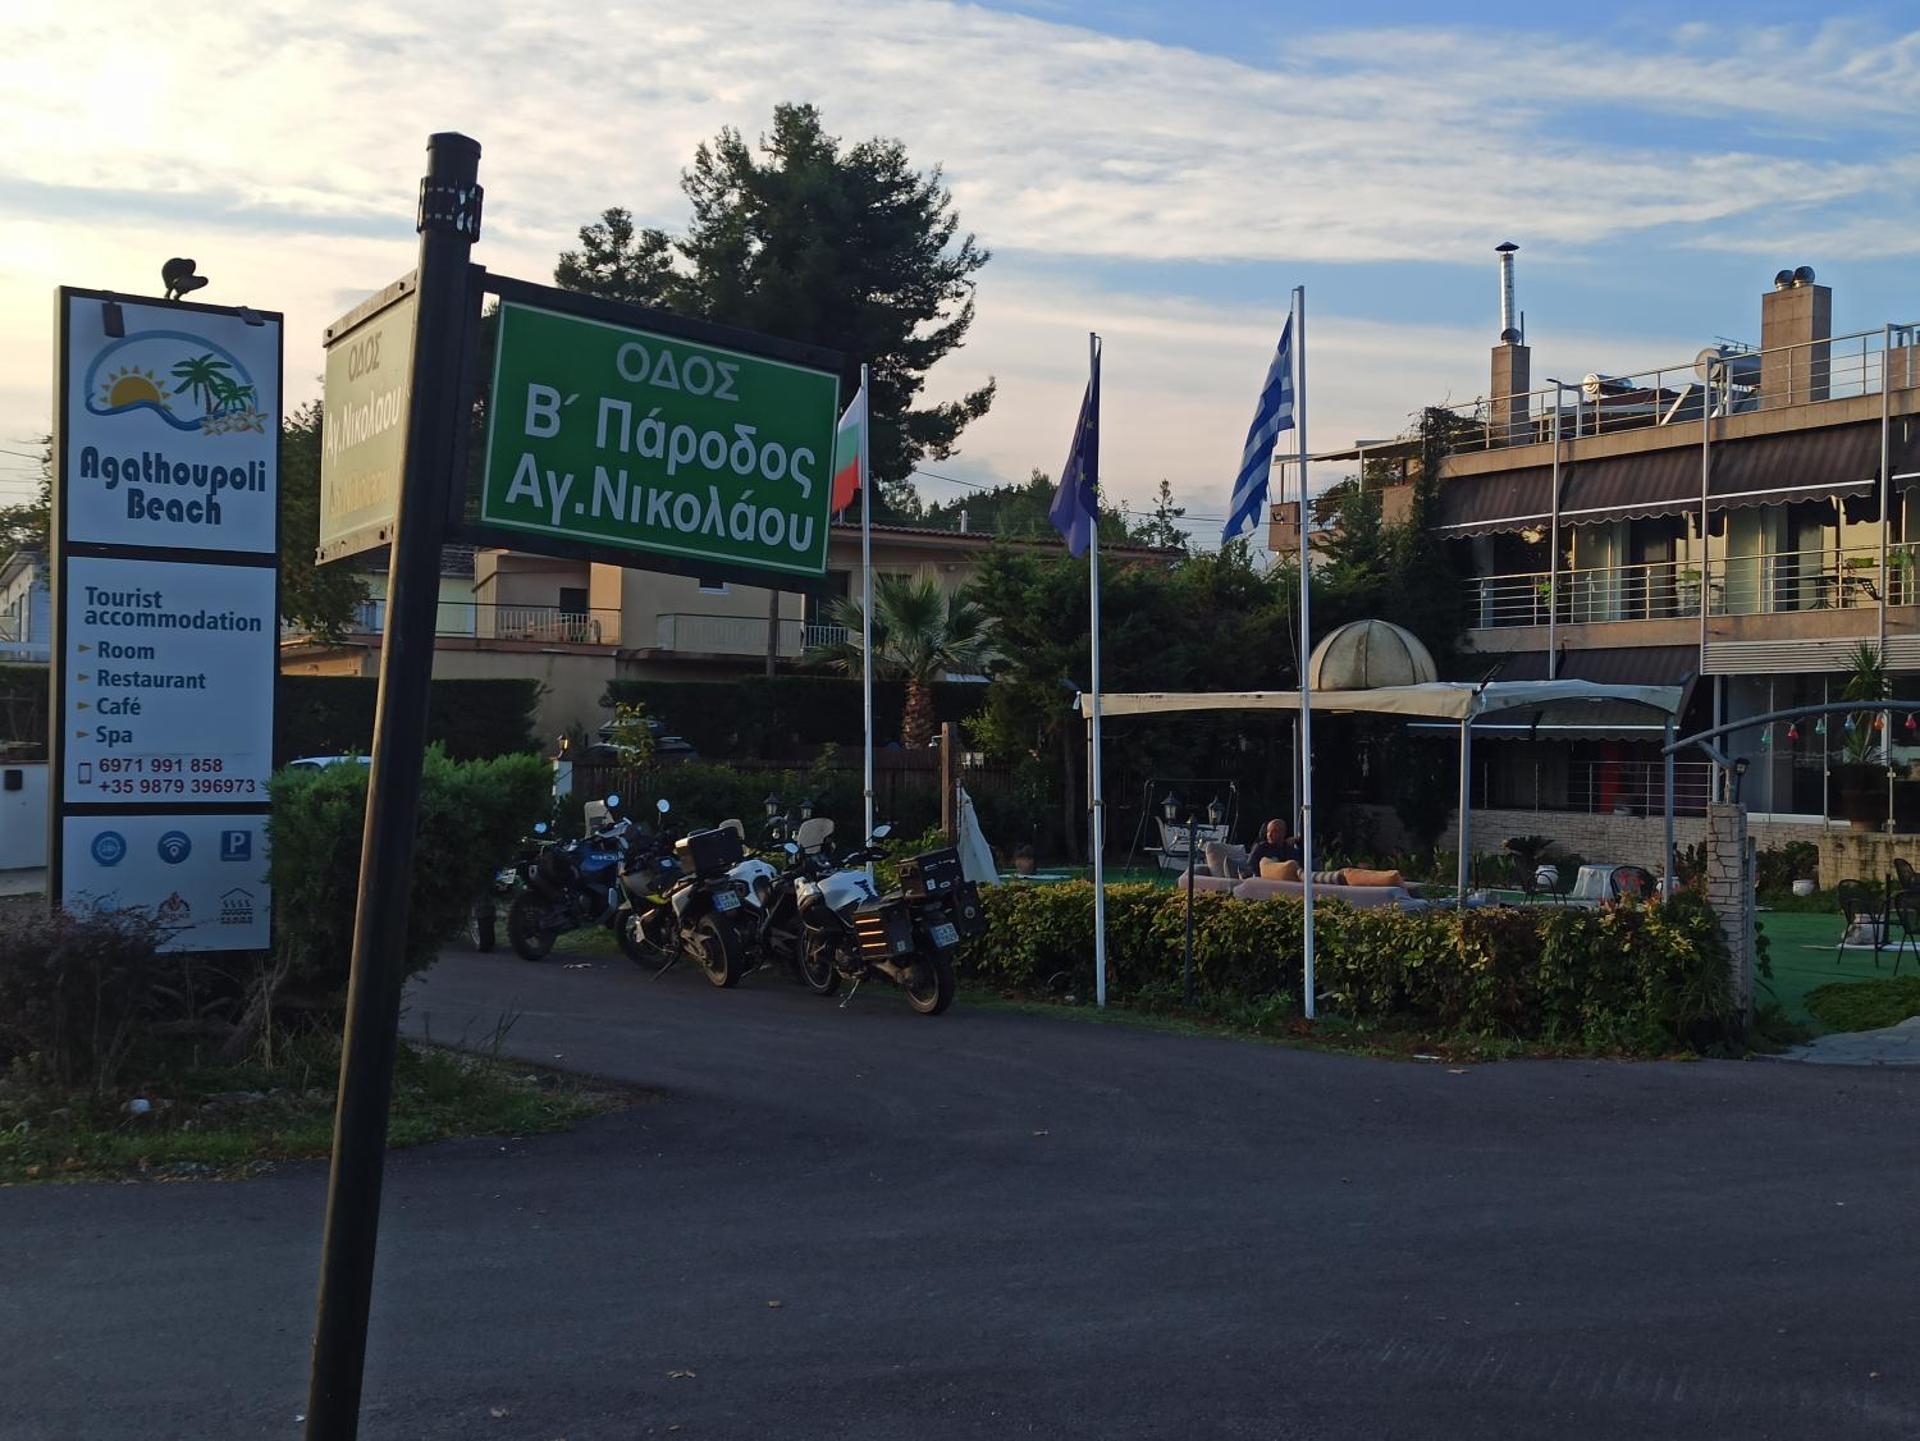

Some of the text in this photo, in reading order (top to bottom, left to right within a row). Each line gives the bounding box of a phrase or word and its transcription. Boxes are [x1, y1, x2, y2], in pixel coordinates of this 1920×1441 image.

[349, 331, 382, 382] ΟΔΟΣ
[616, 342, 740, 402] ΟΔΟΣ
[596, 397, 815, 499] Πάροδος
[80, 446, 266, 496] Agathoupoli
[127, 487, 221, 525] Beach
[85, 586, 162, 609] Tourist
[84, 609, 262, 632] accommodation
[97, 641, 155, 659] Room
[96, 669, 206, 689] Restaurant
[96, 697, 142, 715] Café
[95, 725, 133, 748] Spa
[99, 758, 223, 773] 6971 991 858
[99, 779, 256, 794] +35 9879 396973
